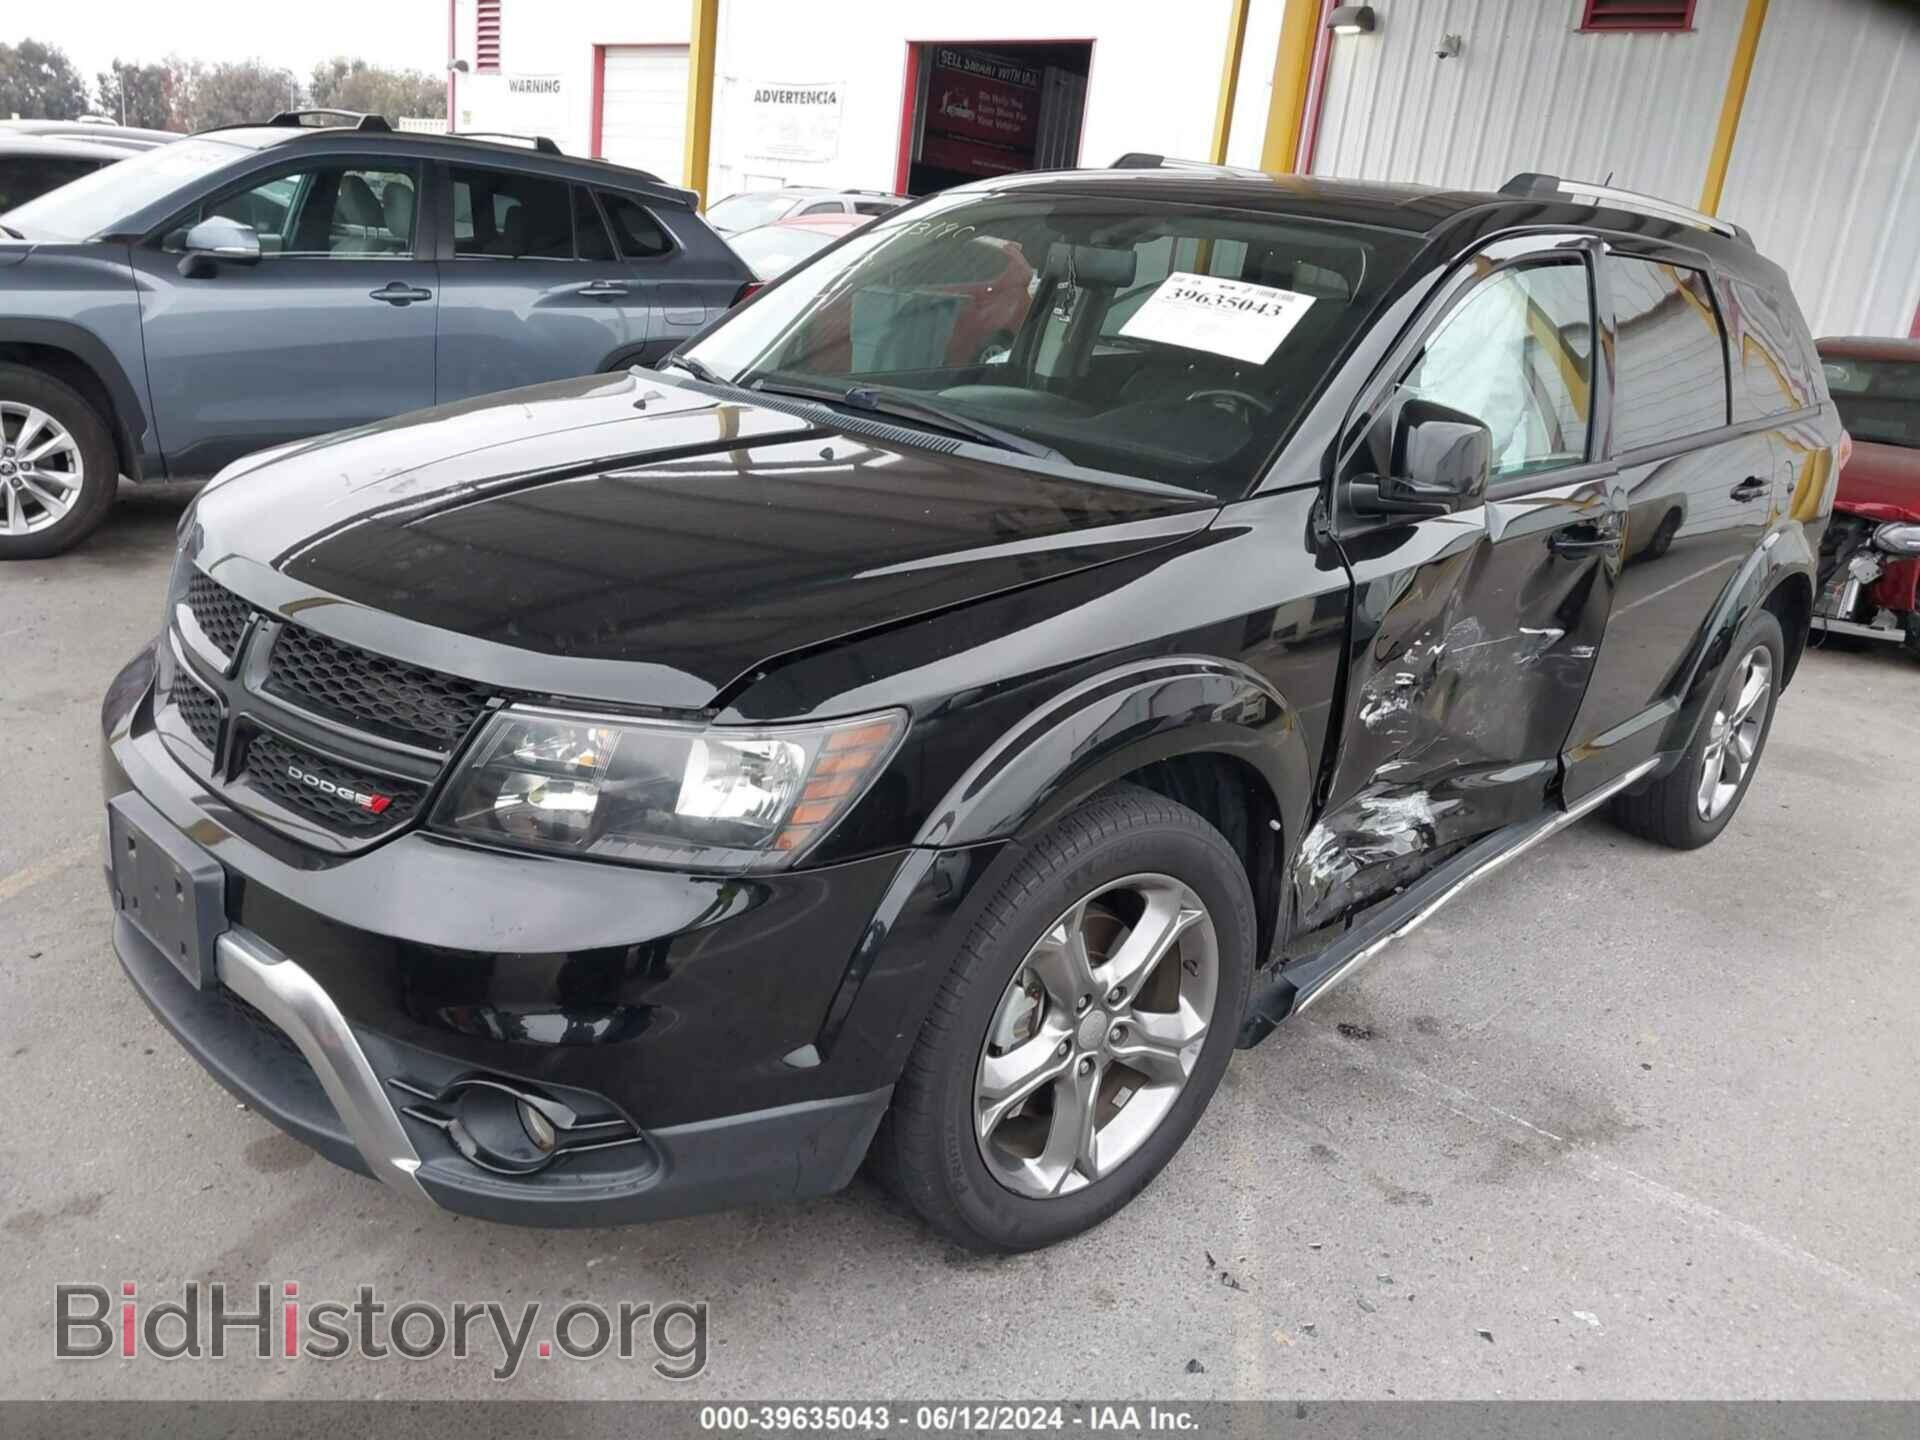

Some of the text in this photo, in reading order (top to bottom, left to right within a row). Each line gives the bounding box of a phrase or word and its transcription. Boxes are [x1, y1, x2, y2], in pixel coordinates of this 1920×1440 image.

[508, 79, 561, 94] WARNING
[753, 89, 837, 105] ADVERTENCIA
[1166, 287, 1283, 318] 39635043
[287, 765, 374, 808] DODGE
